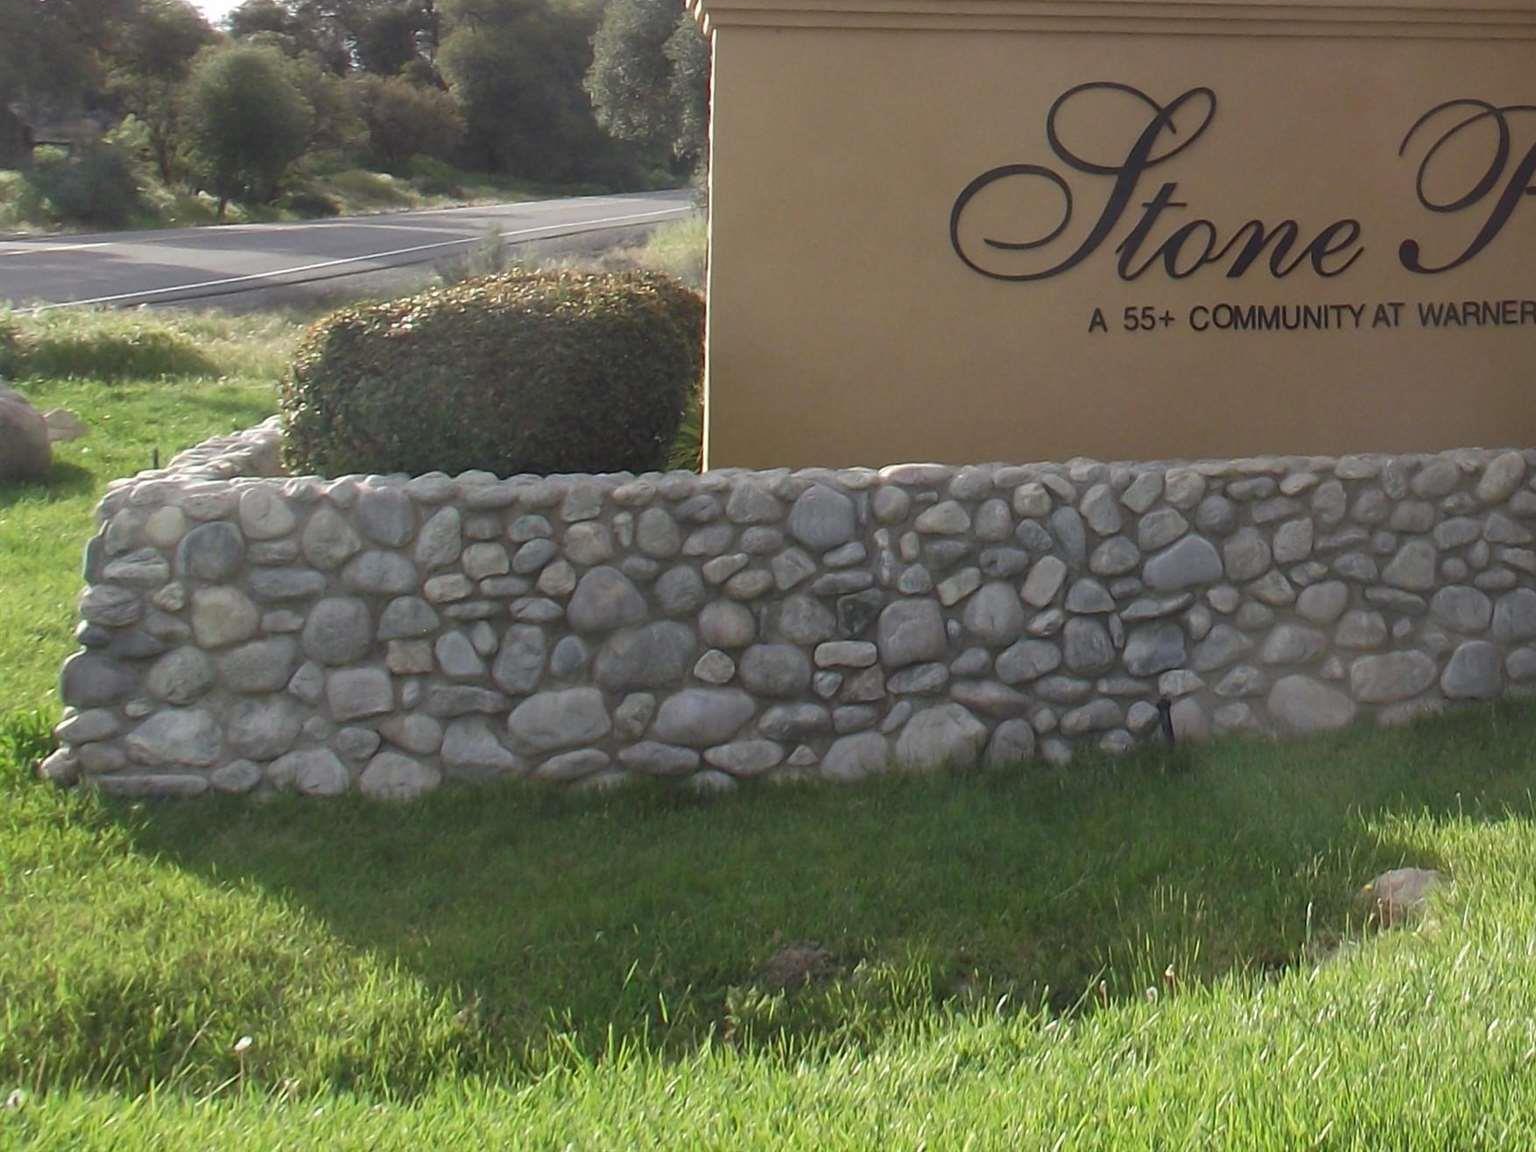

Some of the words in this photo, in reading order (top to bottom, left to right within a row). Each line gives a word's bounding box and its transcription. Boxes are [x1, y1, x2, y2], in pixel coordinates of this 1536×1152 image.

[950, 82, 1365, 282] Stone
[1088, 309, 1108, 334] A
[1123, 307, 1176, 332] 55+
[1189, 304, 1366, 332] COMMUNITY
[1372, 302, 1405, 328] AT
